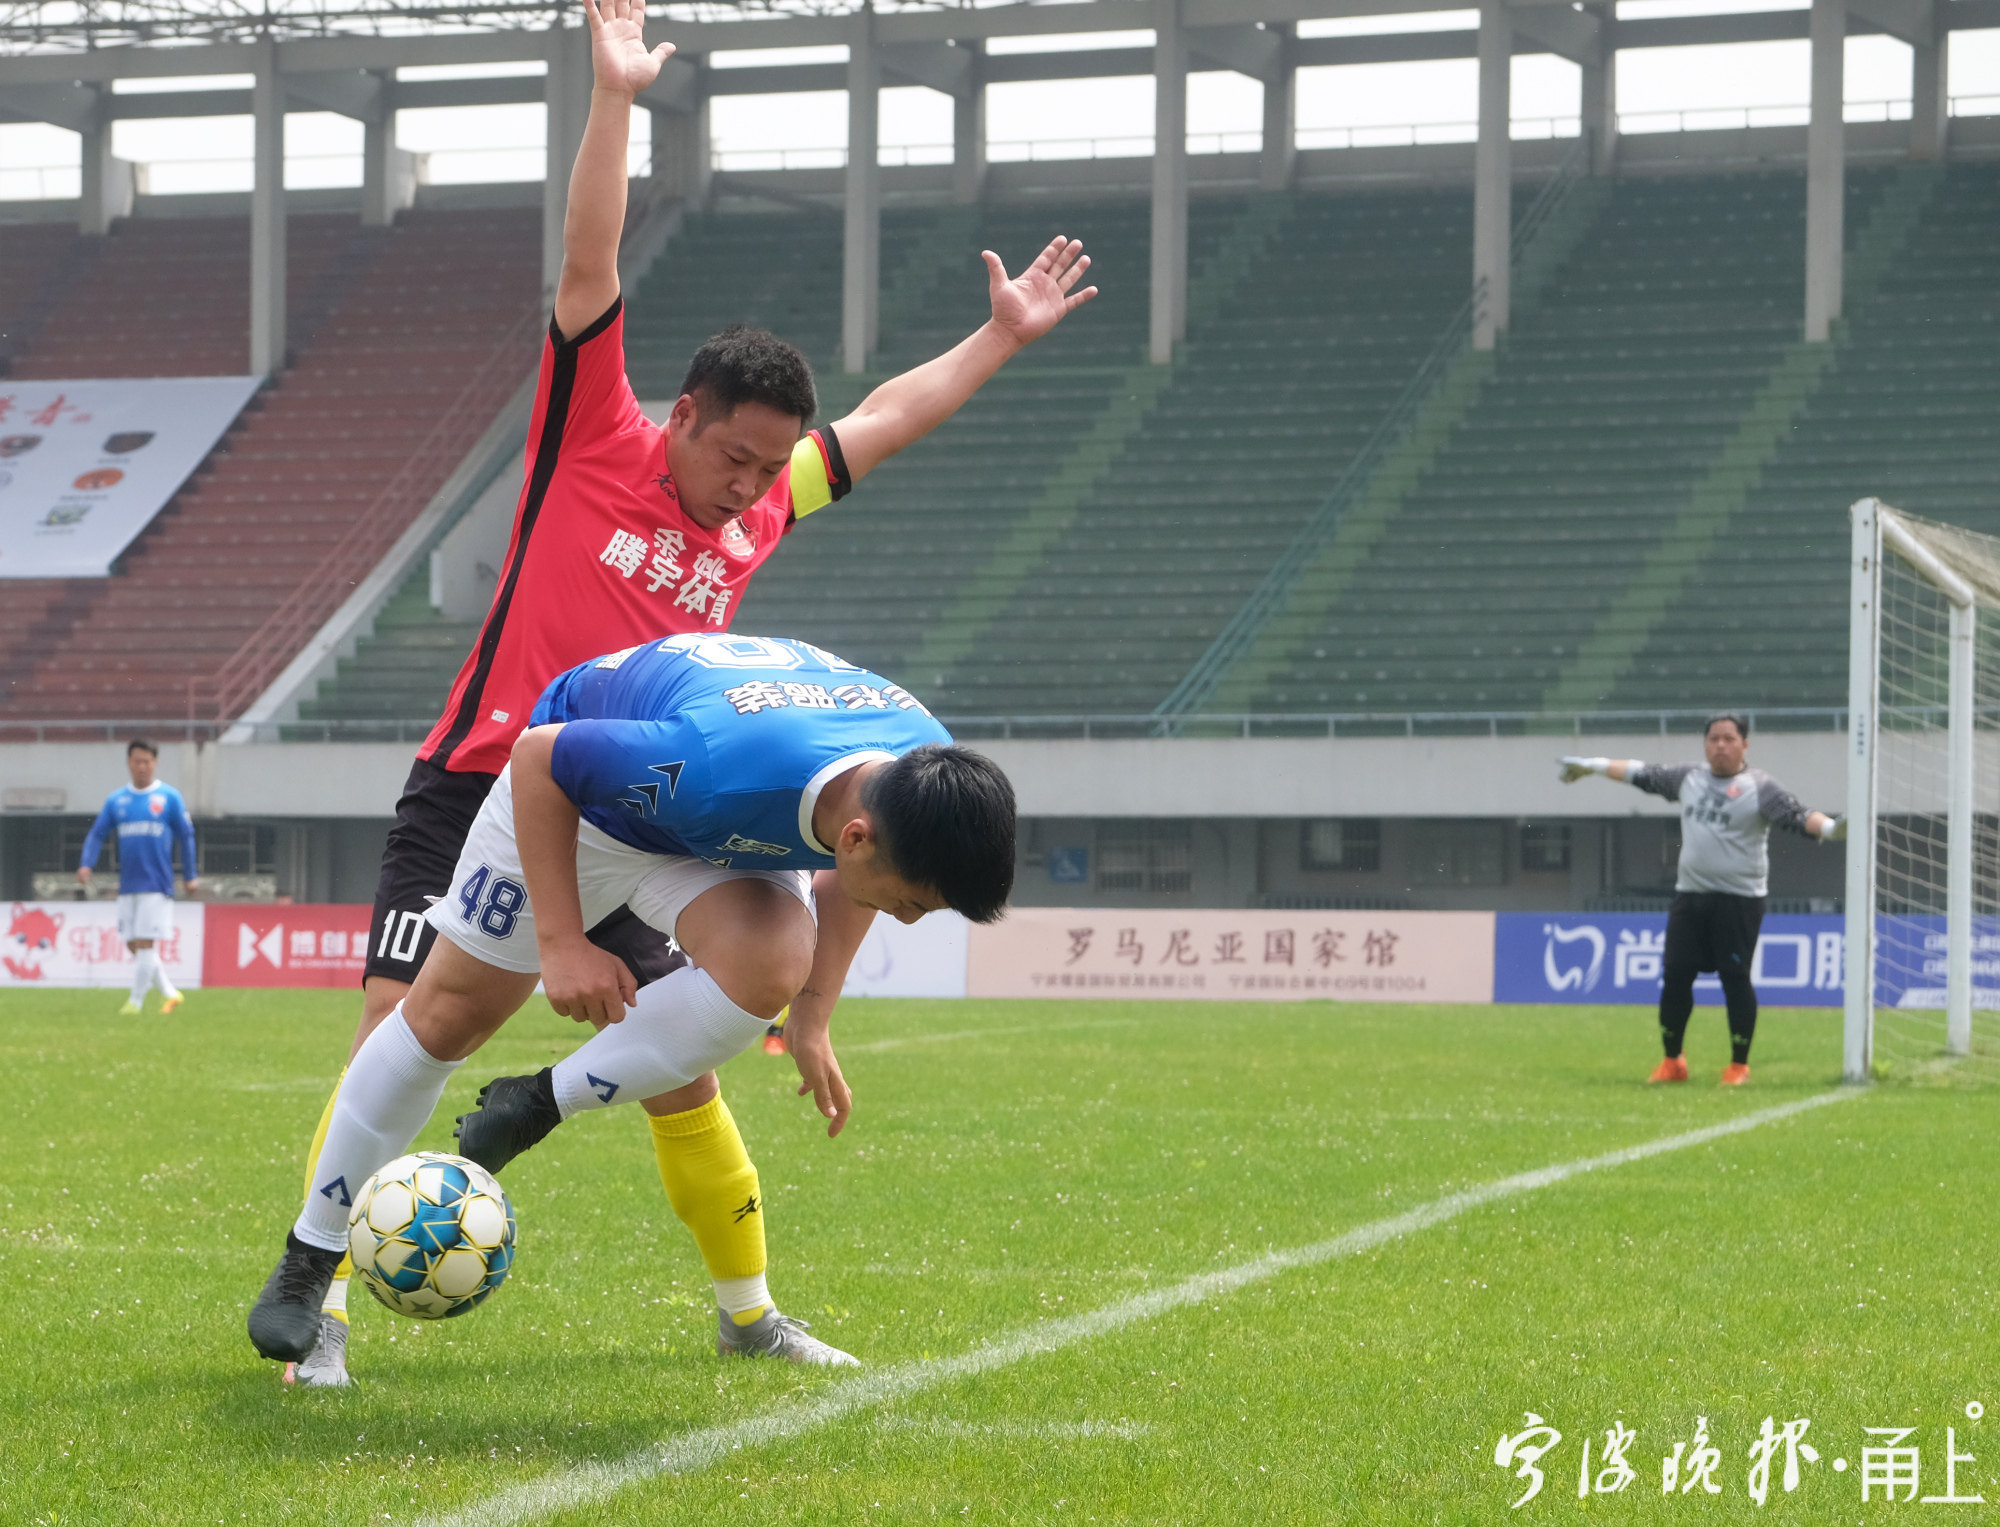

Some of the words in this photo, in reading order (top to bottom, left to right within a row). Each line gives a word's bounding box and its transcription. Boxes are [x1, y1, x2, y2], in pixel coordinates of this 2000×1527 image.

[599, 528, 733, 627] 腾宇体育
[653, 528, 728, 587] 余姚
[458, 862, 528, 941] 48
[376, 909, 425, 963] 10
[1065, 927, 1400, 969] 罗马尼亚国家馆
